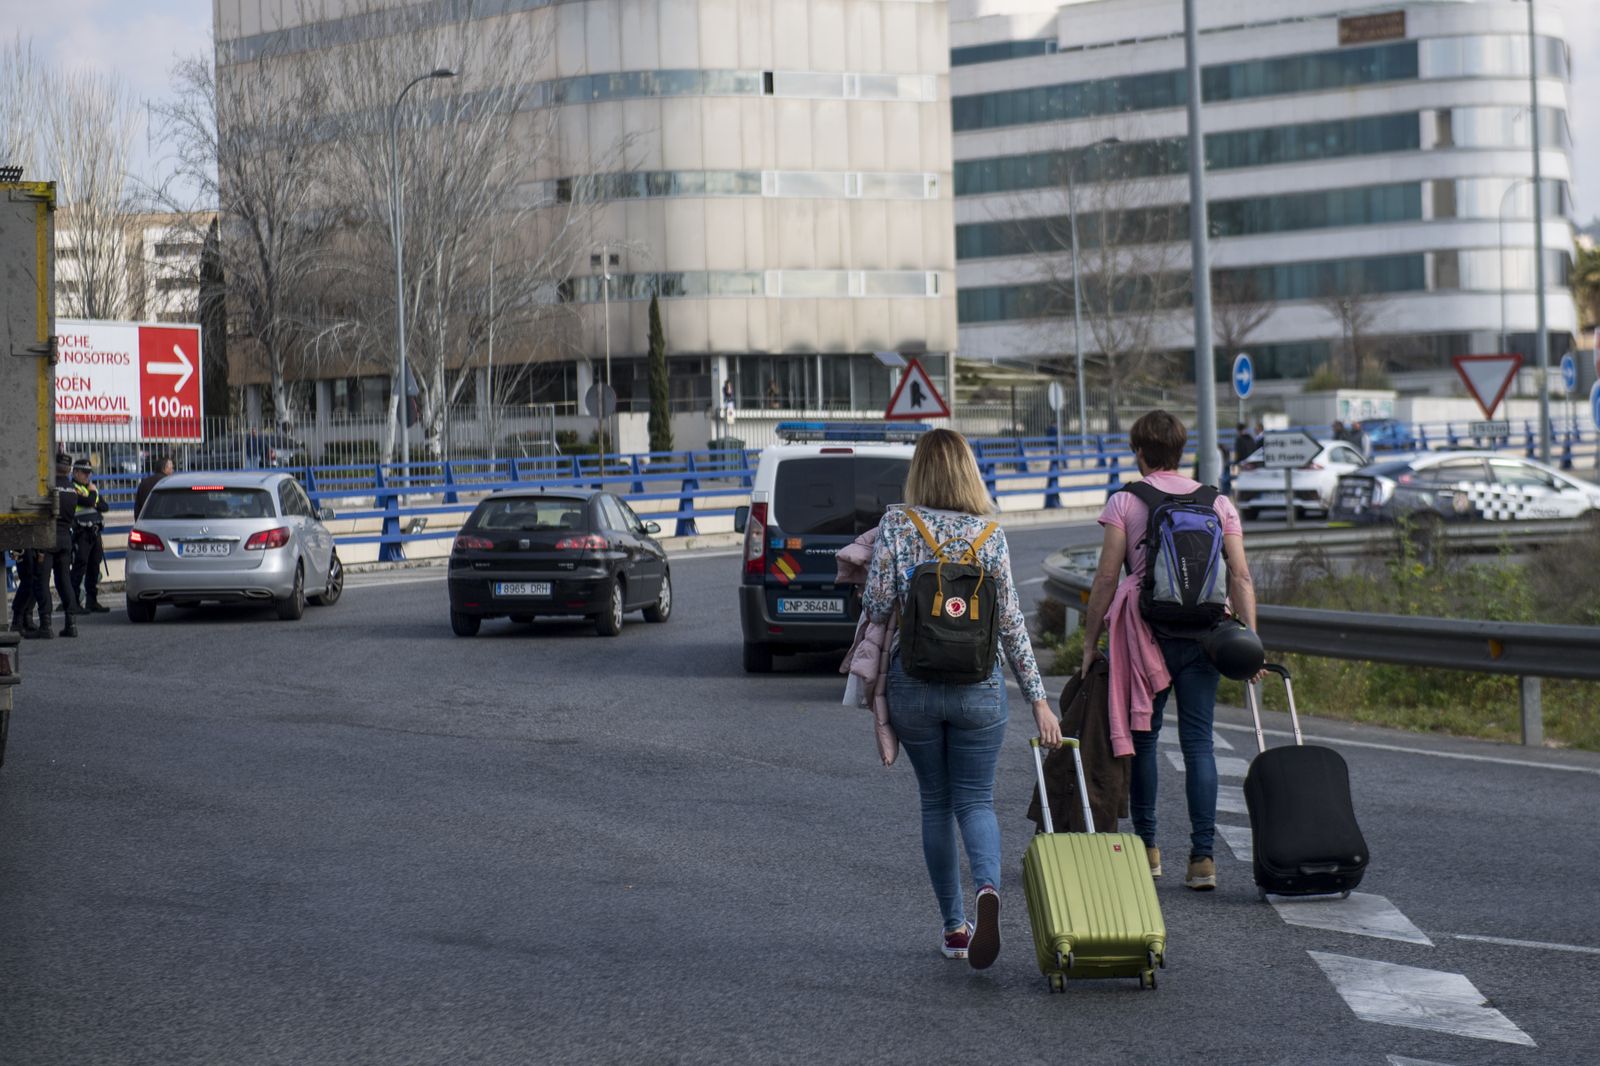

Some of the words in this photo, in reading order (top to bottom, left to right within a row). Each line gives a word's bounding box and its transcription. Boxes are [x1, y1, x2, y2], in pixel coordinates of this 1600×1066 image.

[57, 334, 94, 350] OCHE,
[64, 351, 130, 365] NOSOTROS
[55, 373, 91, 391] ROËN
[55, 393, 130, 411] NDAMÓVIL
[210, 543, 228, 553] KCS
[503, 583, 526, 593] 8965
[531, 583, 548, 593] DRH
